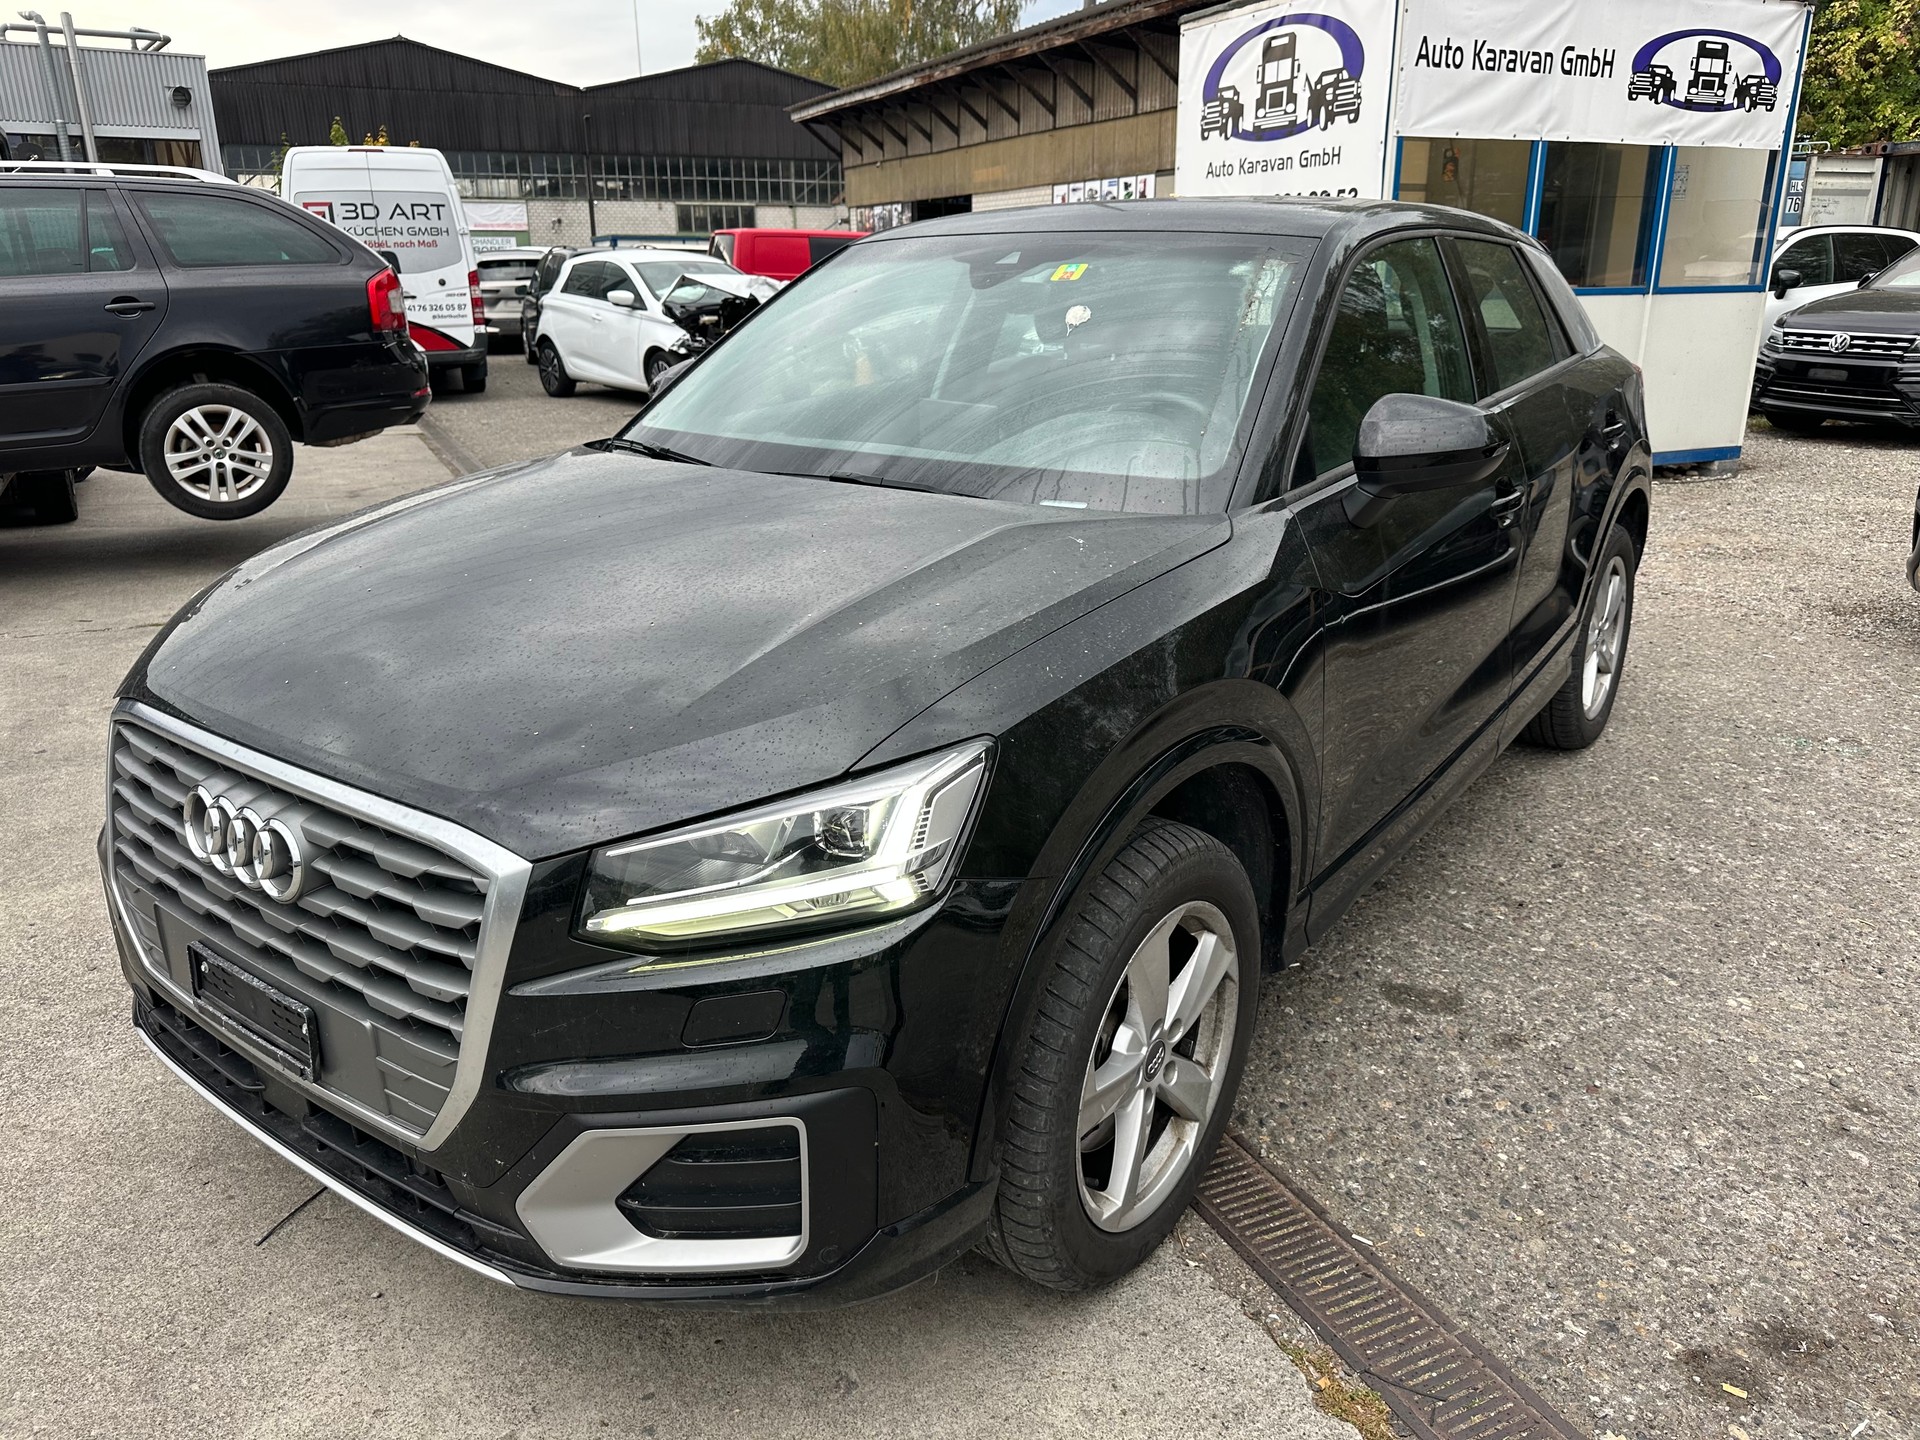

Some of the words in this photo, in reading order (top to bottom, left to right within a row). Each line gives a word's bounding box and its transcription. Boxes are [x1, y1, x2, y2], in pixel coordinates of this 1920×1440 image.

[1415, 35, 1463, 69] Auto
[1472, 39, 1553, 74] Karavan
[1561, 45, 1615, 78] GmbH
[1206, 161, 1234, 179] Auto
[1238, 156, 1293, 175] Karavan
[1299, 145, 1342, 168] GmbH
[340, 203, 380, 220] 3D
[389, 203, 446, 221] ART
[1787, 197, 1801, 213] 76
[343, 224, 403, 236] KÜCHEN
[407, 226, 450, 237] GMBH
[393, 240, 415, 249] nach
[417, 304, 428, 312] 76
[428, 303, 444, 311] 326
[445, 303, 456, 311] 05
[457, 303, 467, 311] 87
